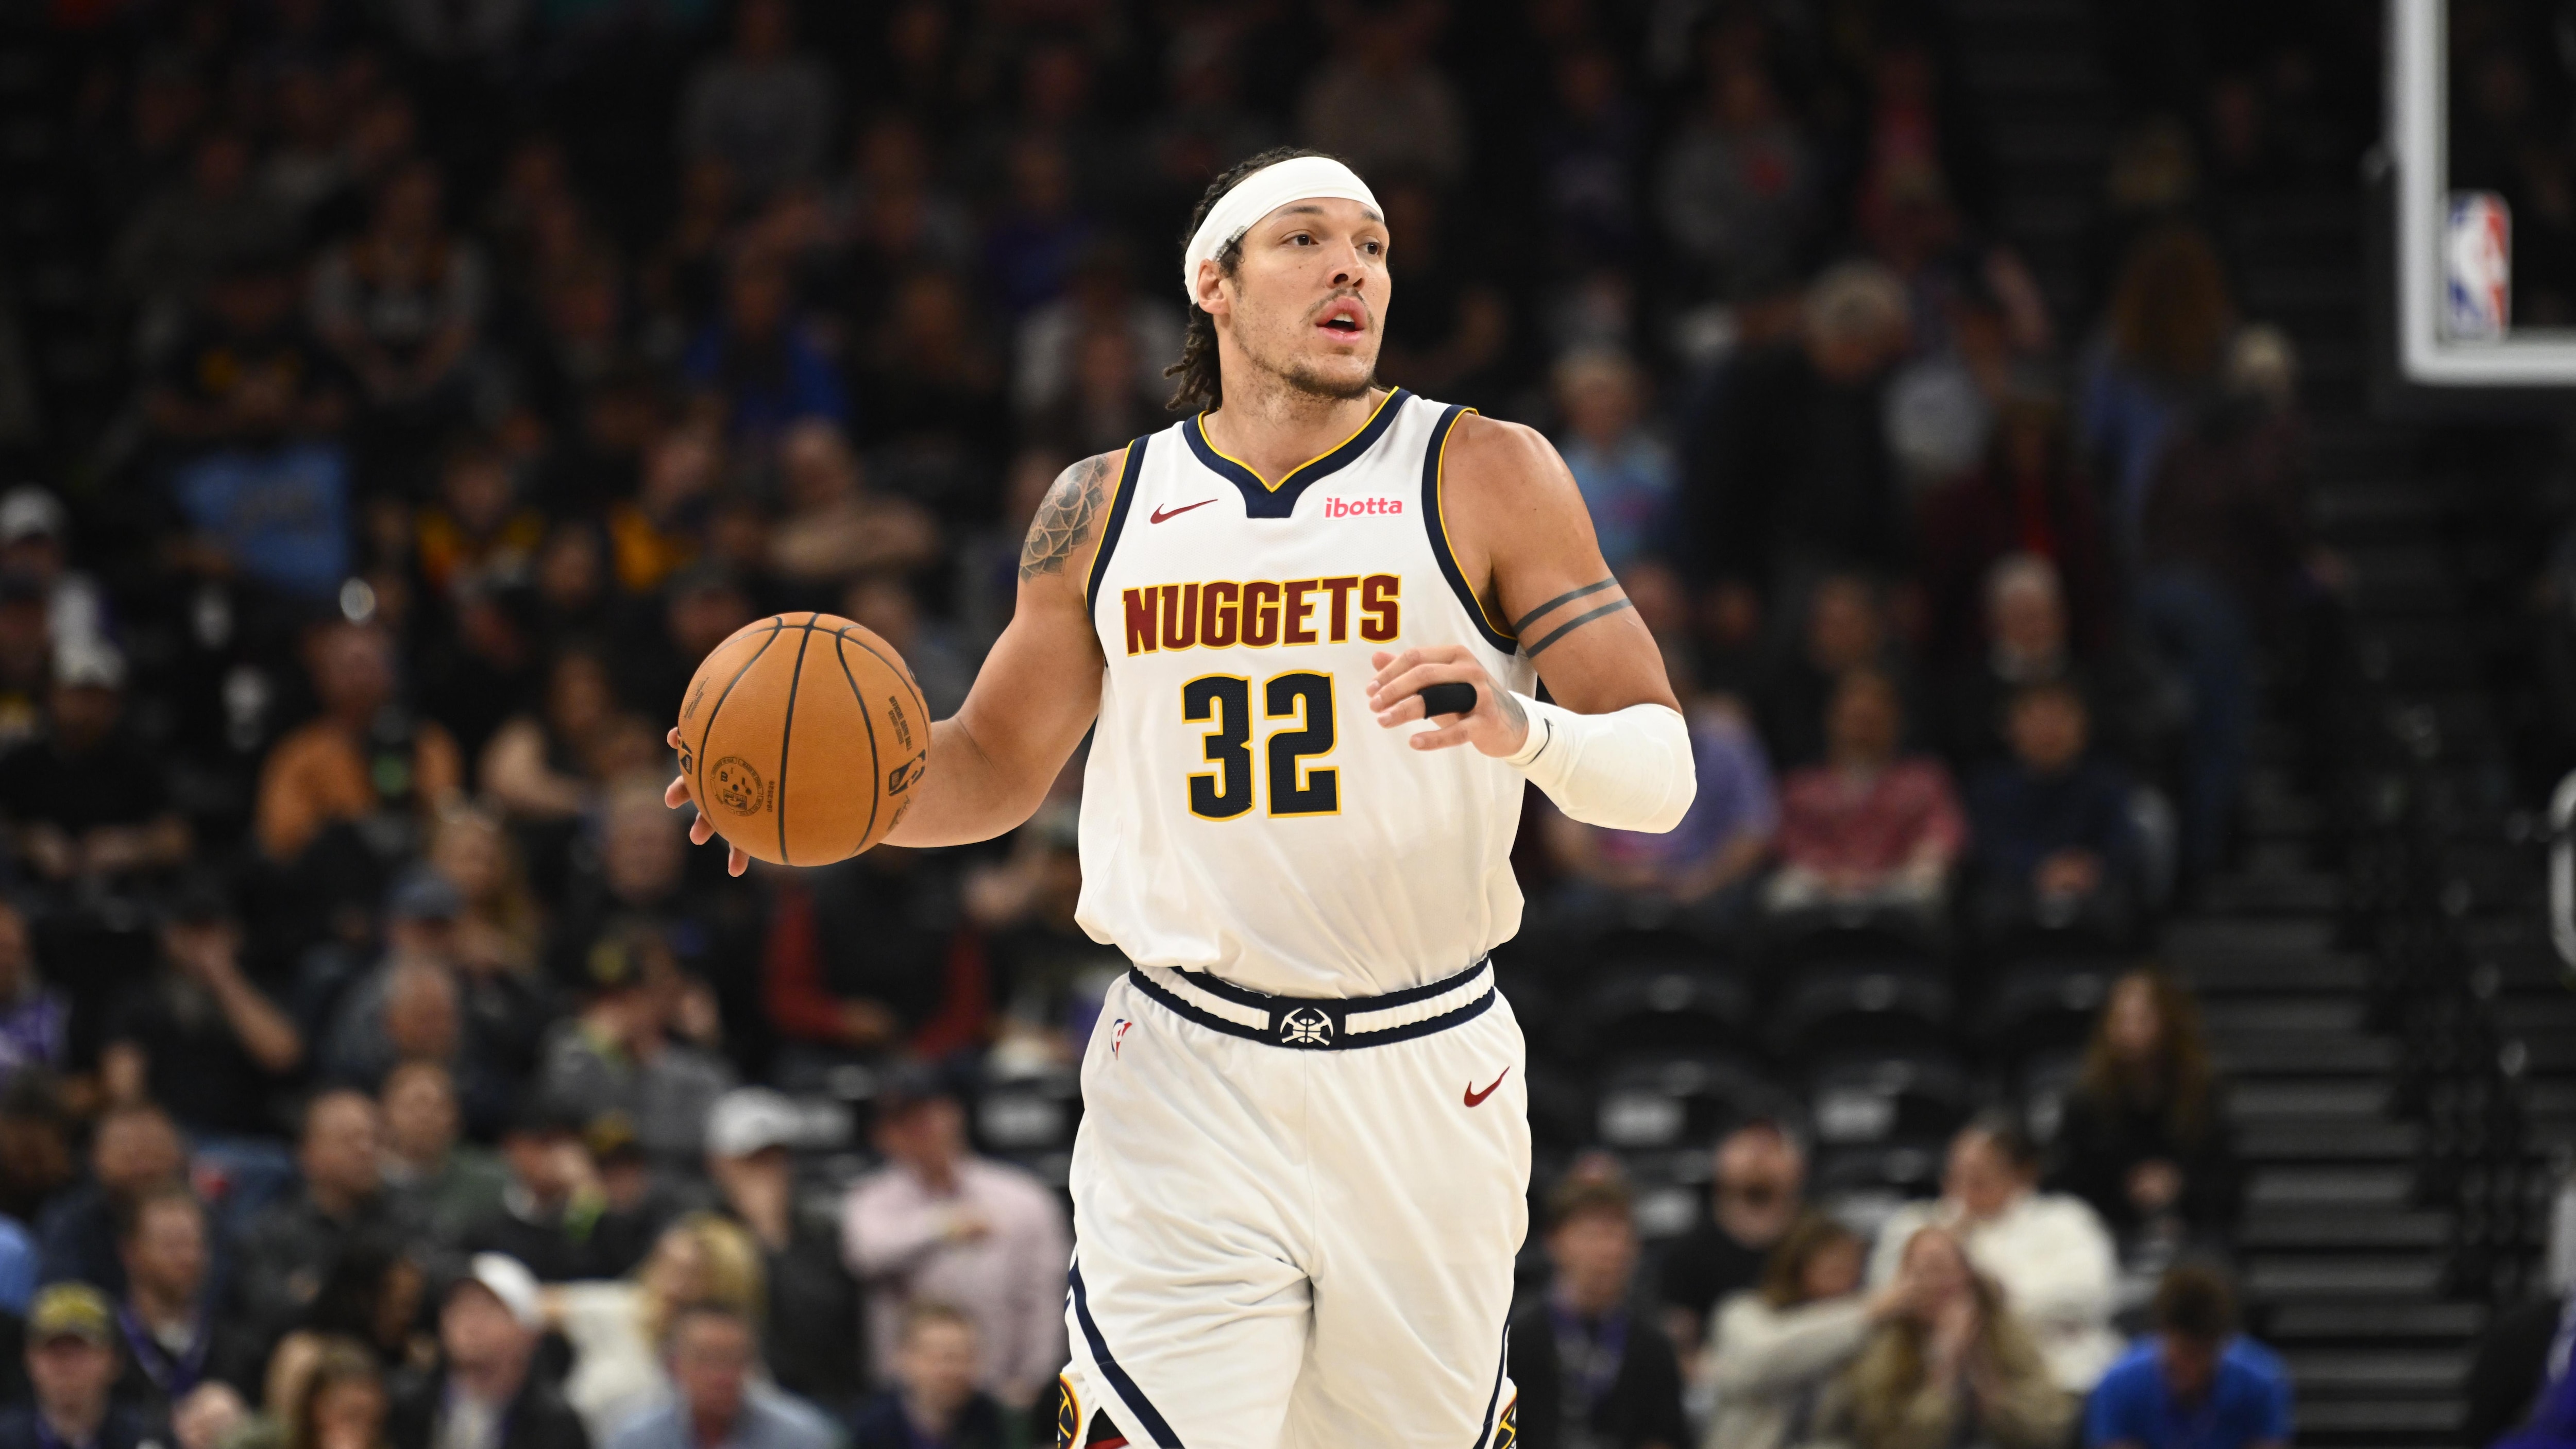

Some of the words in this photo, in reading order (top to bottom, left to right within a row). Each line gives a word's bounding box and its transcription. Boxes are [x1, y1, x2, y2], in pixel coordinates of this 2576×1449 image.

[1326, 498, 1403, 518] ibotta
[1122, 573, 1402, 657] NUGGETS
[1180, 670, 1342, 822] 32
